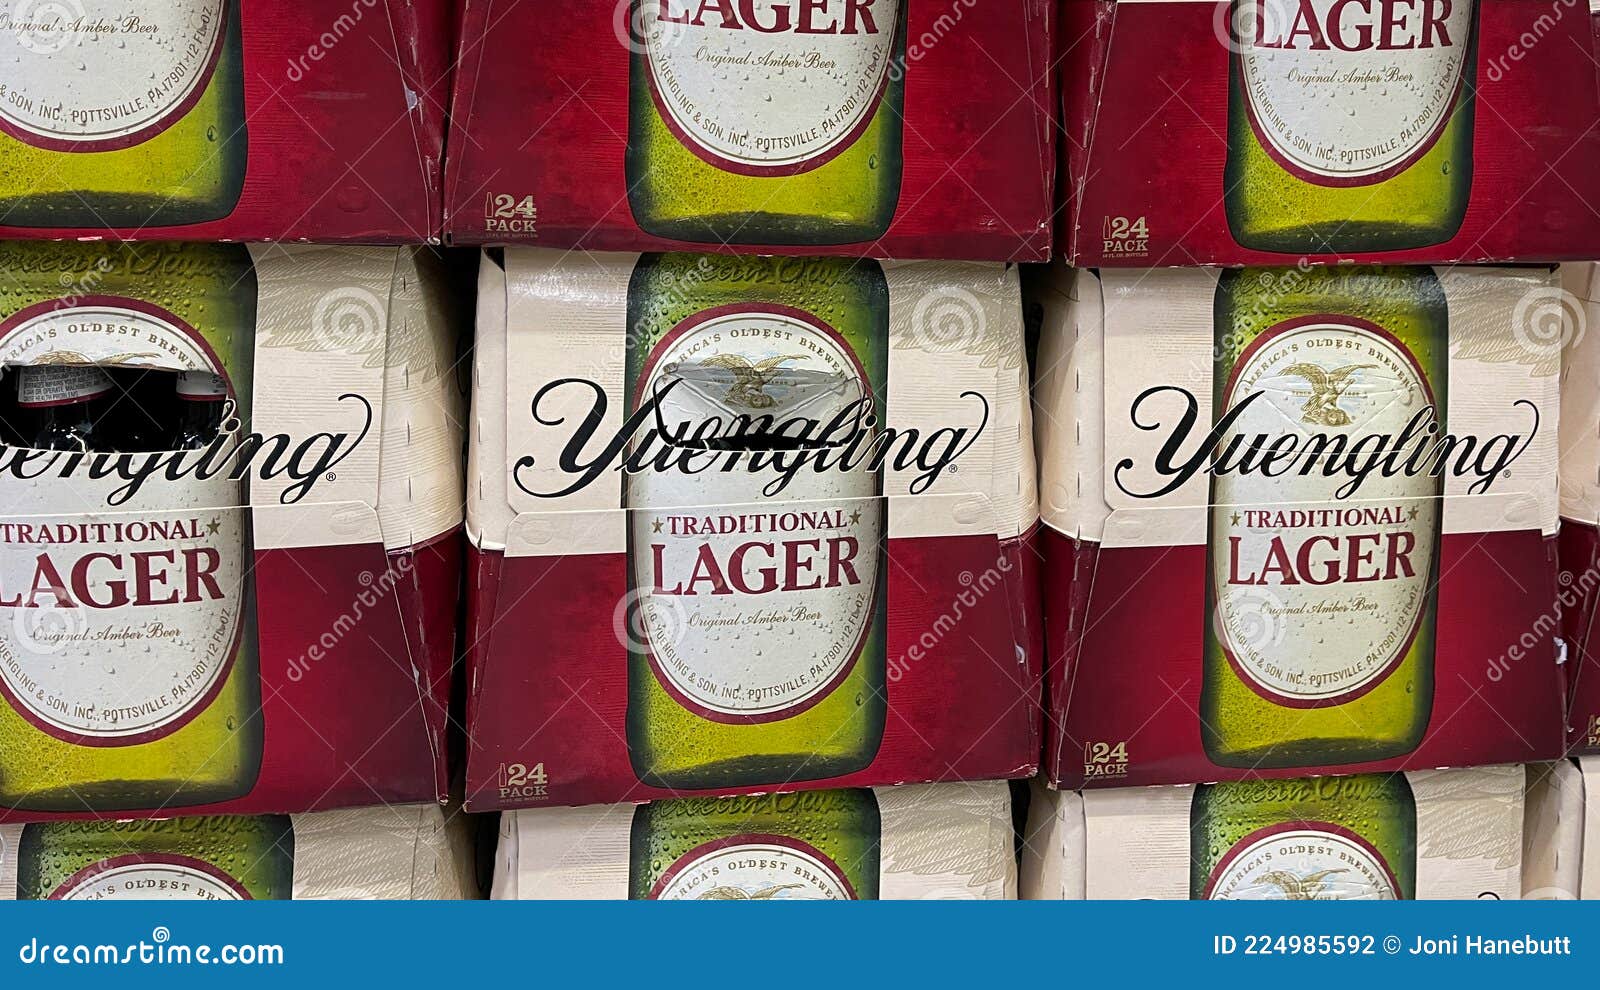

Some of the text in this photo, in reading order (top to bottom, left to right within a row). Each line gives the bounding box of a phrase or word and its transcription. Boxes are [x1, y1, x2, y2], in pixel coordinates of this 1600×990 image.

[0, 13, 160, 39] Original Amber Beer
[1254, 0, 1452, 51] LAGER
[694, 46, 837, 70] Original Amber Beer
[658, 54, 696, 116] YUENGLING
[695, 111, 703, 124] &
[1287, 66, 1414, 88] Original Amber Beer
[1254, 79, 1287, 134] YUENGLING
[1284, 128, 1293, 142] &
[495, 194, 537, 218] 24
[485, 219, 537, 232] PACK
[1111, 216, 1149, 239] 24
[1103, 240, 1149, 252] PACK
[7, 322, 197, 371] RICA'S OLDEST BREWE
[730, 328, 793, 341] OLDEST
[799, 337, 848, 382] BREWER
[1306, 338, 1363, 351] OLDEST
[512, 378, 989, 498] Yuengling
[1114, 385, 1539, 499] Yuengling
[666, 509, 848, 535] TRADITIONAL
[1244, 506, 1407, 529] TRADITIONAL
[0, 518, 205, 544] TRADITIONAL
[650, 536, 861, 597] LAGER
[1227, 531, 1417, 586] LAGER
[687, 606, 823, 632] Original Amber Beer
[1260, 596, 1379, 617] Original Amber Beer
[32, 622, 181, 648] Original Amber Beer
[654, 624, 689, 676] YUENGLING
[688, 671, 697, 683] &
[1257, 658, 1264, 669] &
[37, 689, 45, 701] &
[1092, 742, 1129, 764] 24
[508, 762, 548, 786] 24
[1084, 763, 1129, 776] PACK
[499, 785, 548, 798] PACK
[125, 879, 190, 892] OLDEST
[677, 866, 720, 900] RICA'S
[727, 859, 788, 872] OLDEST
[1222, 852, 1273, 900] MERICA'S
[1279, 845, 1334, 857] OLDEST
